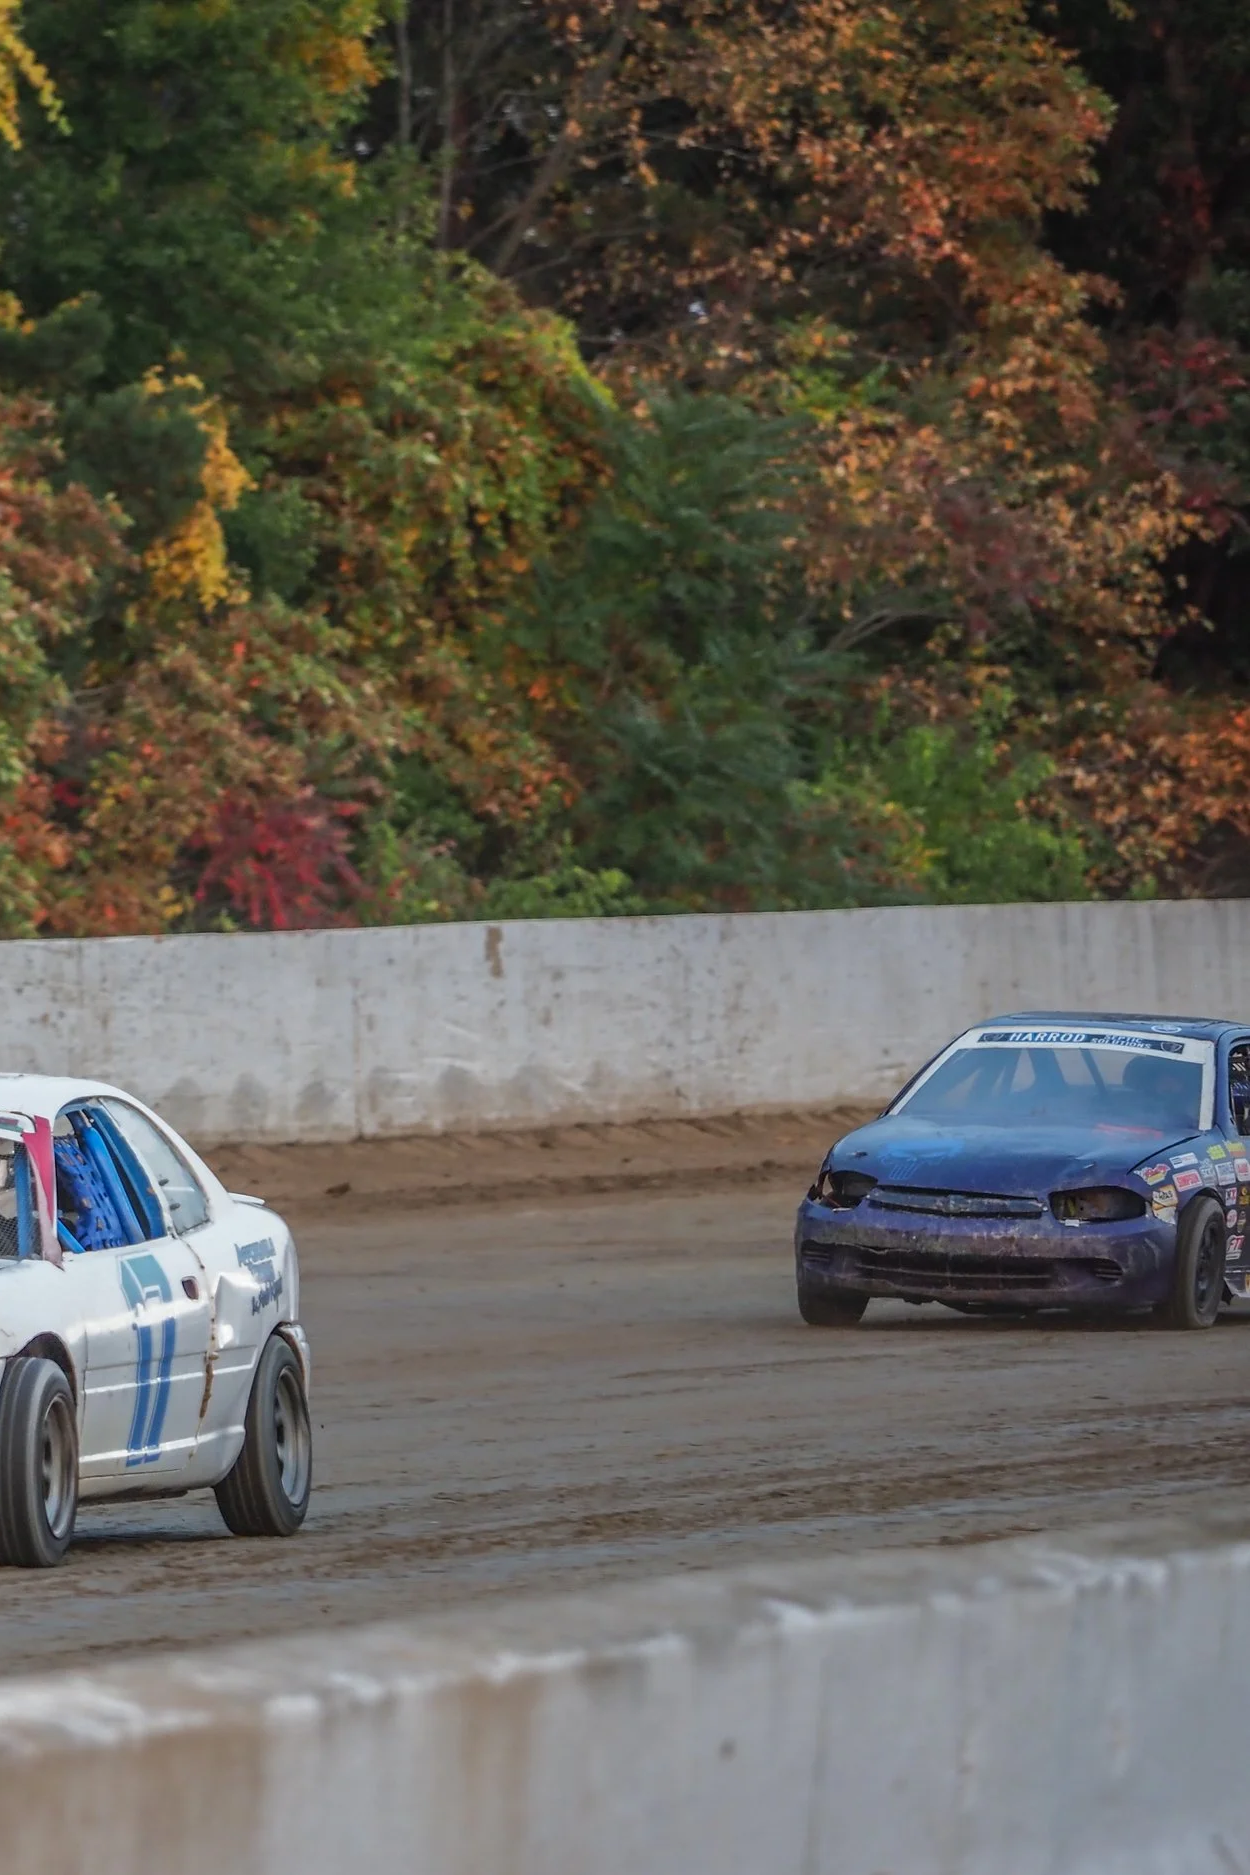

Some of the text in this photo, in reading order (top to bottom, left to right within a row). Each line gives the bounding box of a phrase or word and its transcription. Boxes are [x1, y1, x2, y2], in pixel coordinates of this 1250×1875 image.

[1009, 1032, 1085, 1043] HARROD
[1091, 1037, 1151, 1049] SOLUTIONS
[1103, 1034, 1143, 1043] SEPTIC
